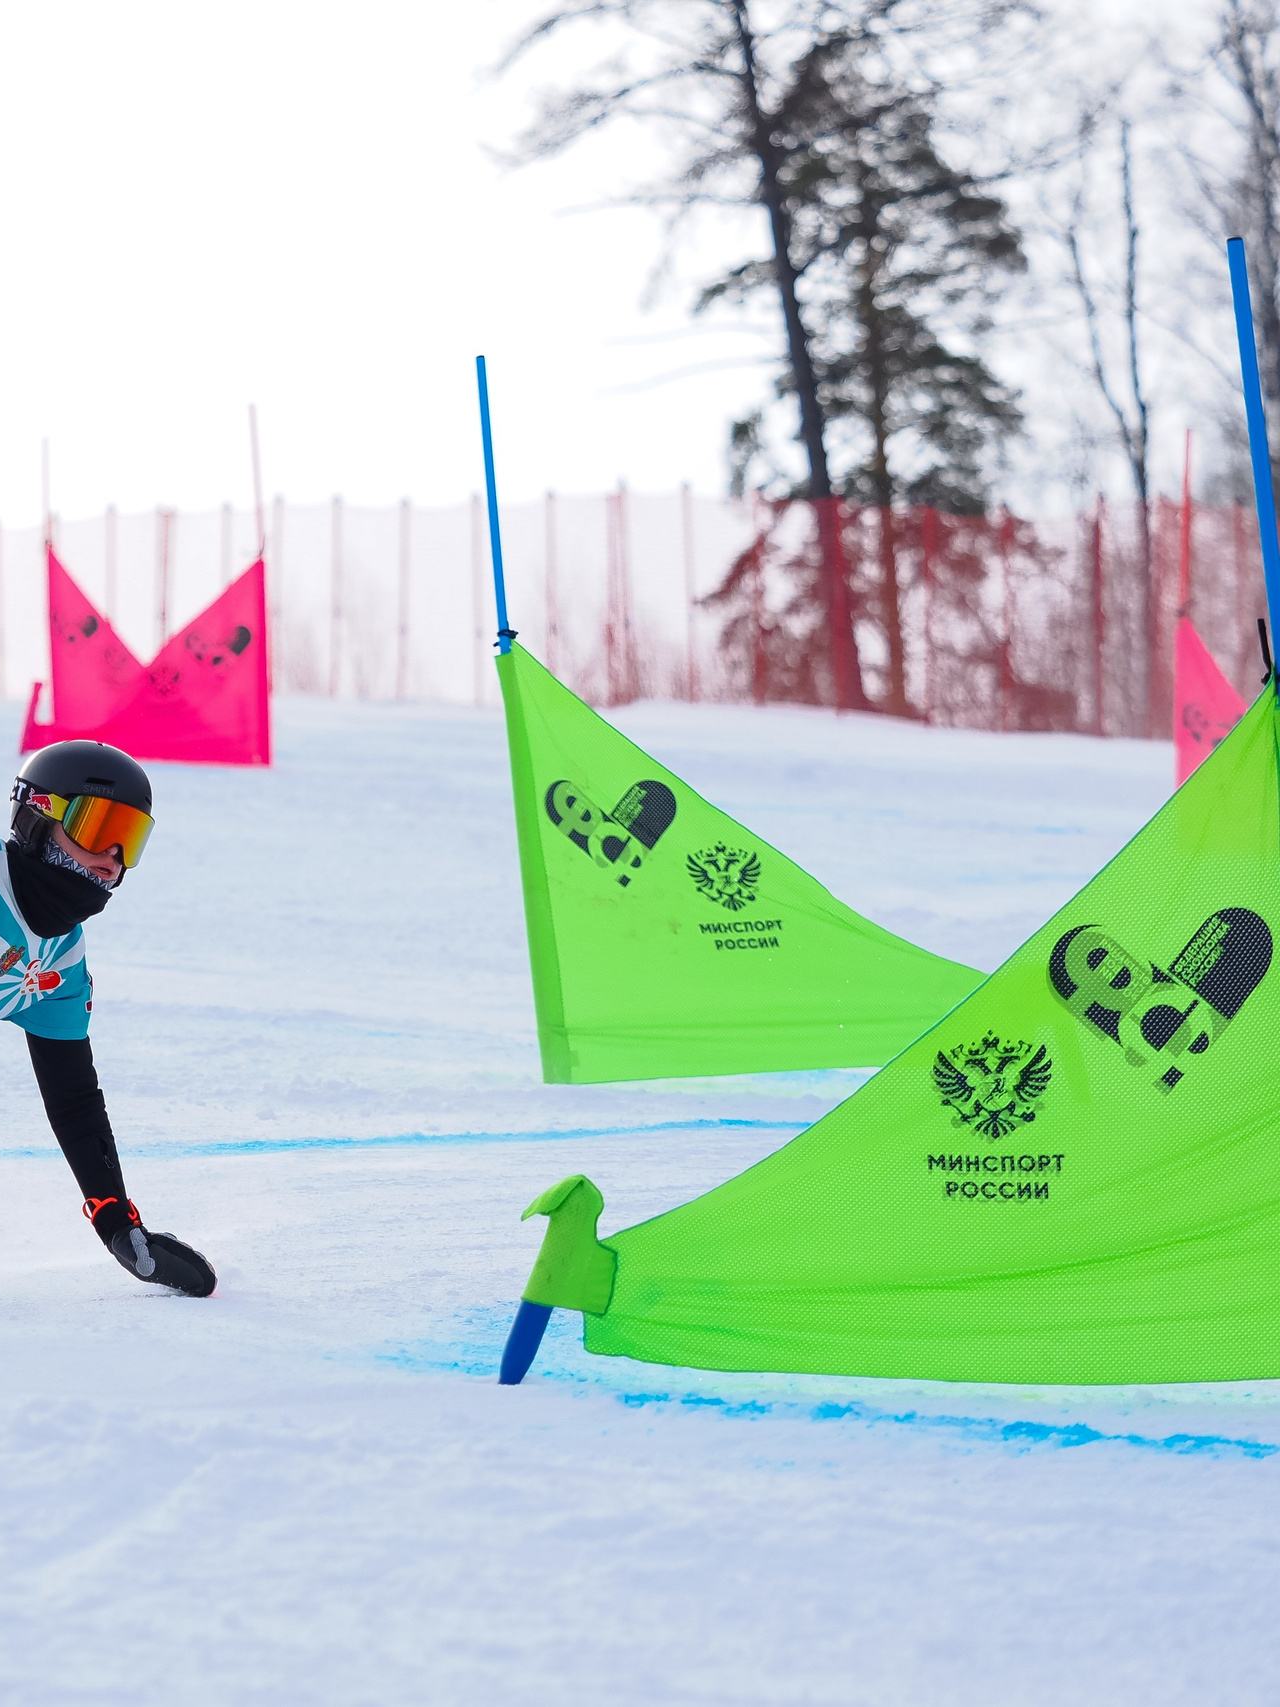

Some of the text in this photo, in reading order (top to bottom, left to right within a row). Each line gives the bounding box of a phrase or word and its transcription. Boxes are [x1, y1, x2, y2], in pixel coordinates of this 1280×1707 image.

[83, 784, 114, 797] SMITH
[699, 919, 783, 934] МИНСПОРТ
[714, 936, 779, 950] РОССИИ
[1172, 915, 1221, 971] ФЕДЕРАЦИЯ
[1187, 944, 1224, 987] РОССИИ
[927, 1154, 1065, 1172] МИНСПОРТ
[945, 1181, 1049, 1199] РОССИИ
